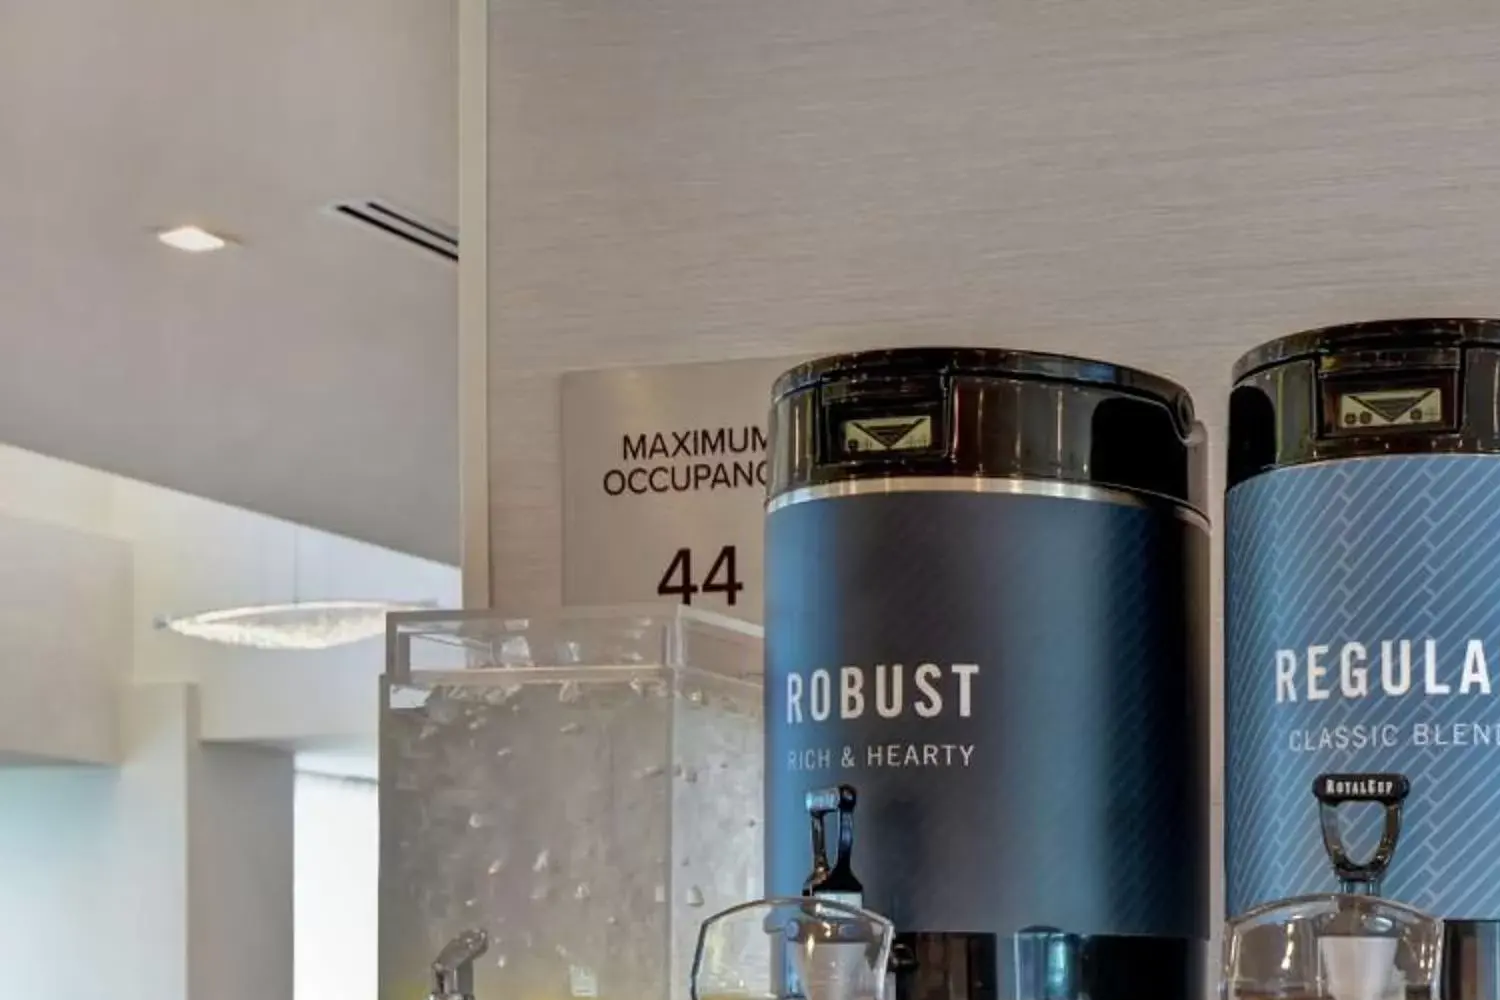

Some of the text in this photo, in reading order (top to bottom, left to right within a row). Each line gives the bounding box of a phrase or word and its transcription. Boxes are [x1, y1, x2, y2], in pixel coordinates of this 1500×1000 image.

[657, 545, 743, 606] 44
[786, 663, 981, 725] ROBUST
[788, 743, 975, 772] RICH & HEARTY
[1289, 724, 1399, 752] CLASSIC
